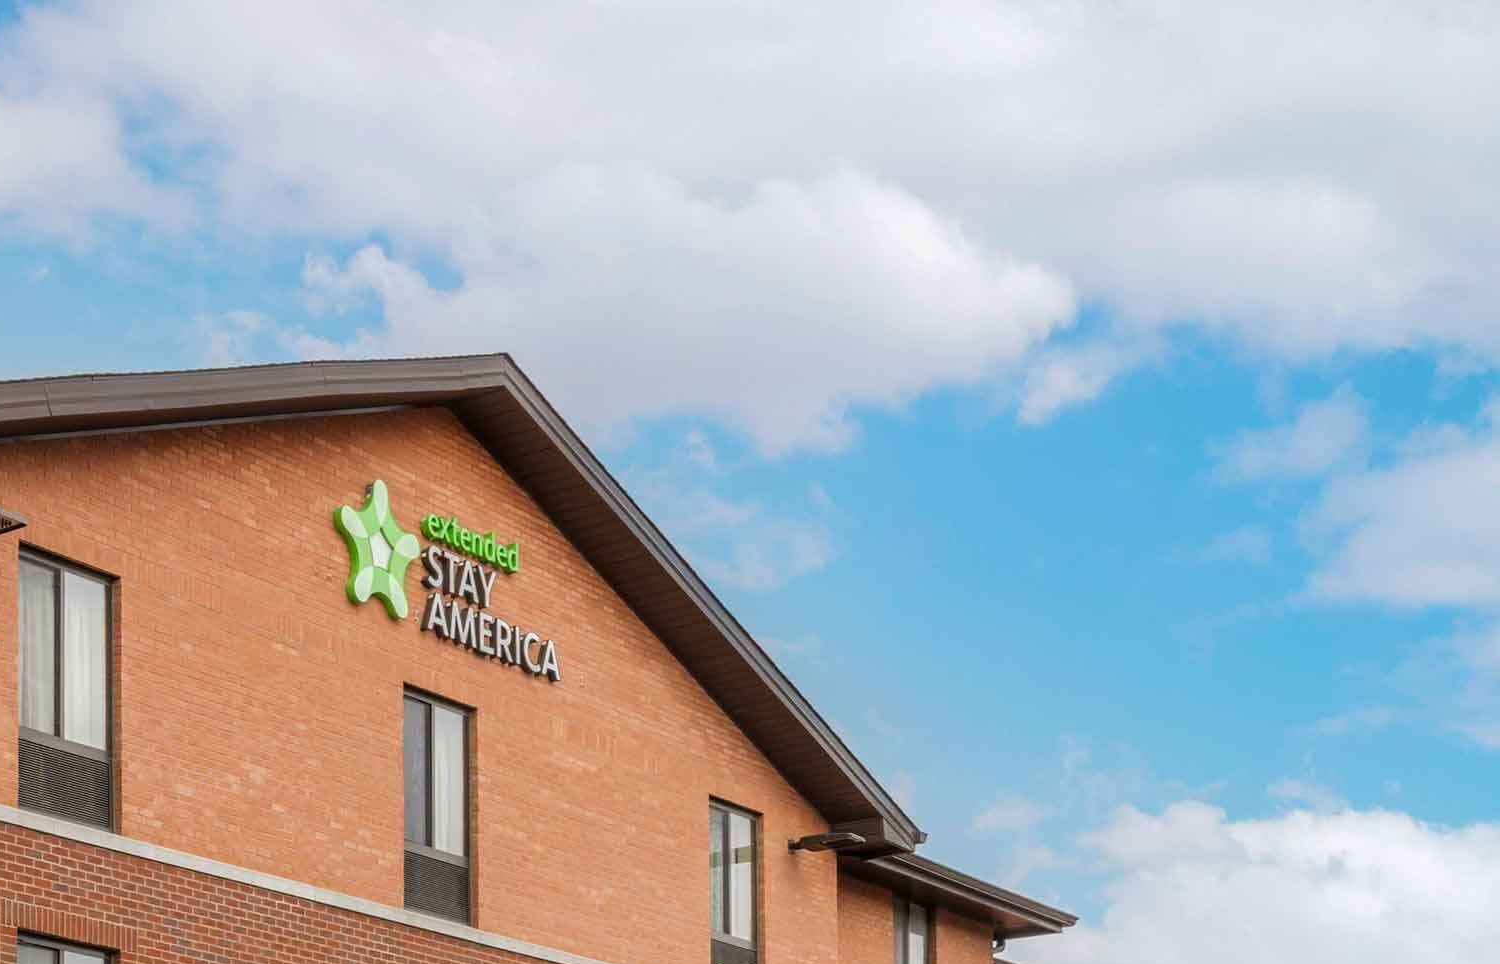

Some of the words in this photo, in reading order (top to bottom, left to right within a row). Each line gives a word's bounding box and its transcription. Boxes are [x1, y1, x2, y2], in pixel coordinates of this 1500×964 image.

[422, 514, 520, 573] extended
[423, 545, 496, 608] STAY
[423, 592, 561, 681] AMERICA
